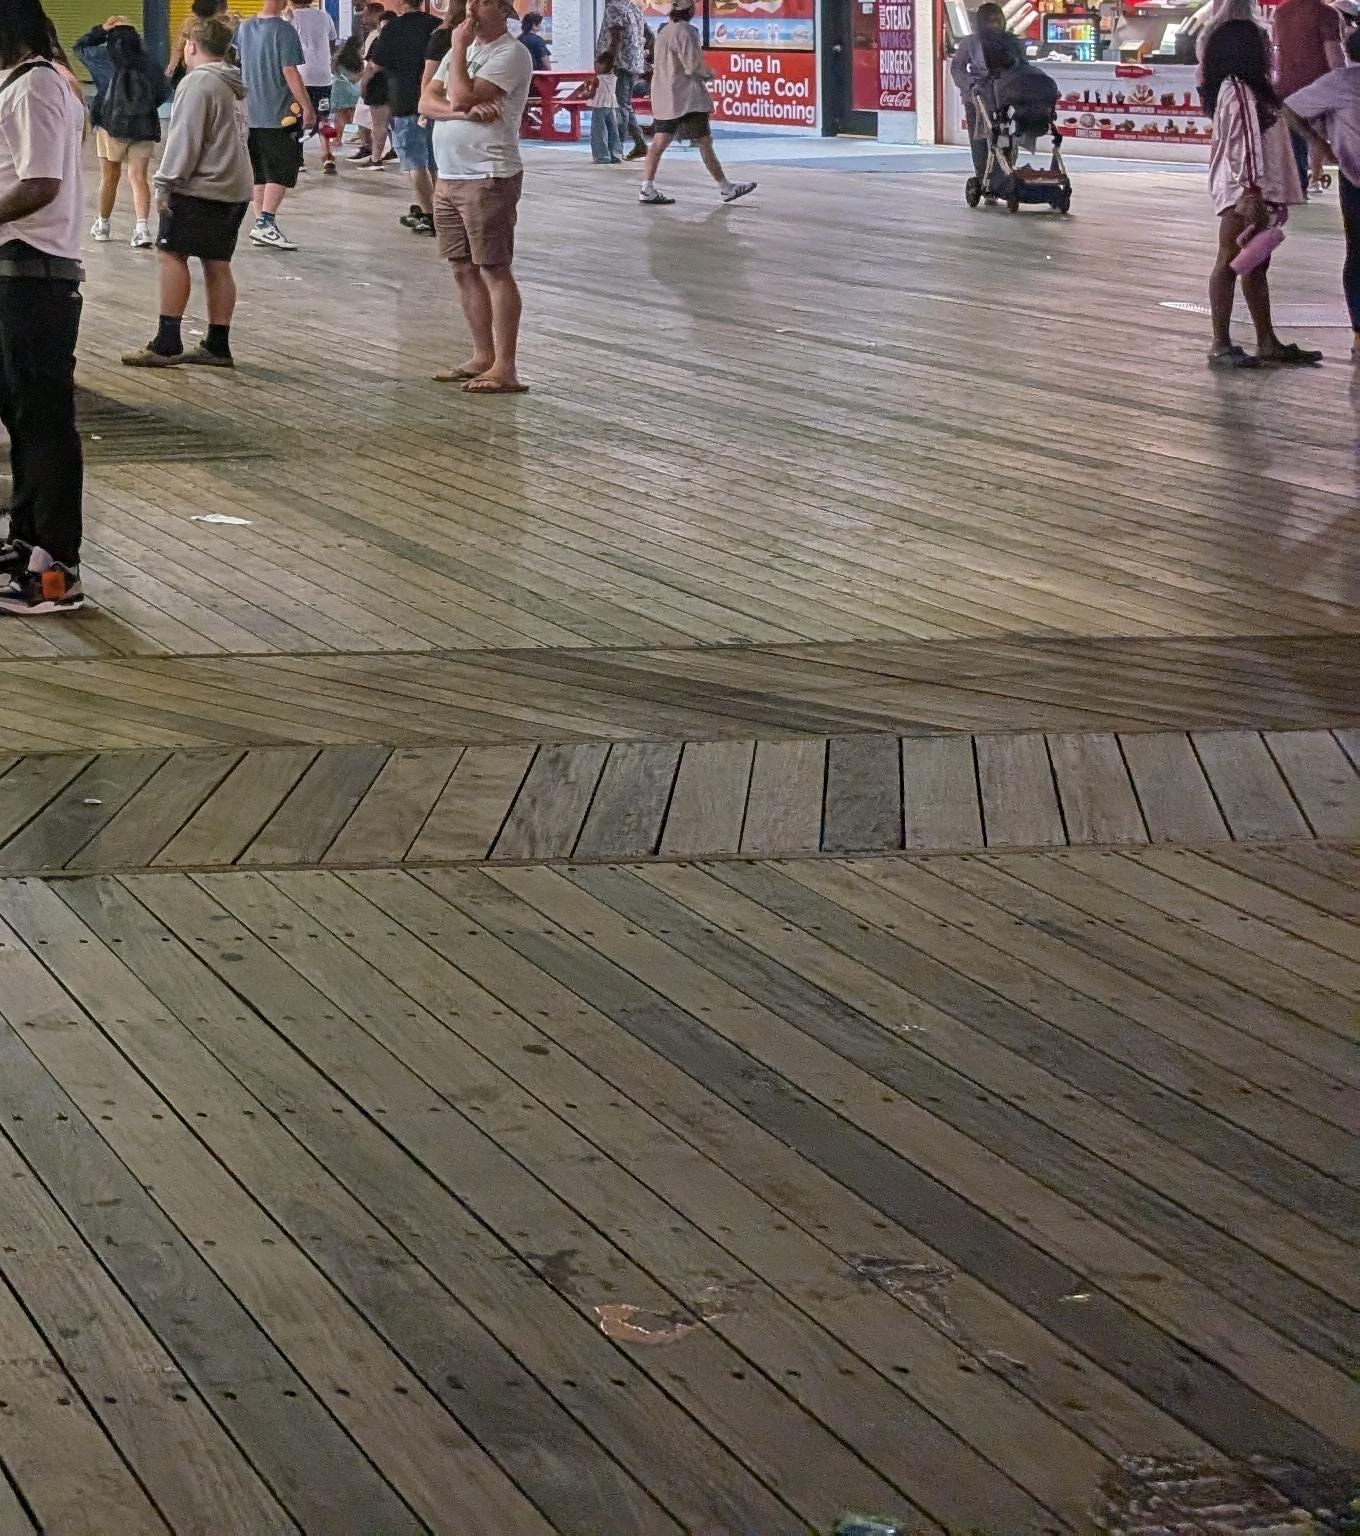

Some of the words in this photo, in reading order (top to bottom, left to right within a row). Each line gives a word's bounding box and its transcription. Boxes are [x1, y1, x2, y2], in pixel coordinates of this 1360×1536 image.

[885, 5, 911, 30] STEAKS
[880, 31, 911, 49] WINGS
[730, 54, 763, 73] Dine
[767, 55, 781, 74] In
[879, 50, 912, 75] BURGERS
[747, 76, 770, 96] the
[774, 77, 809, 98] Cool
[880, 74, 912, 91] WRAPS
[722, 97, 815, 124] Conditioning
